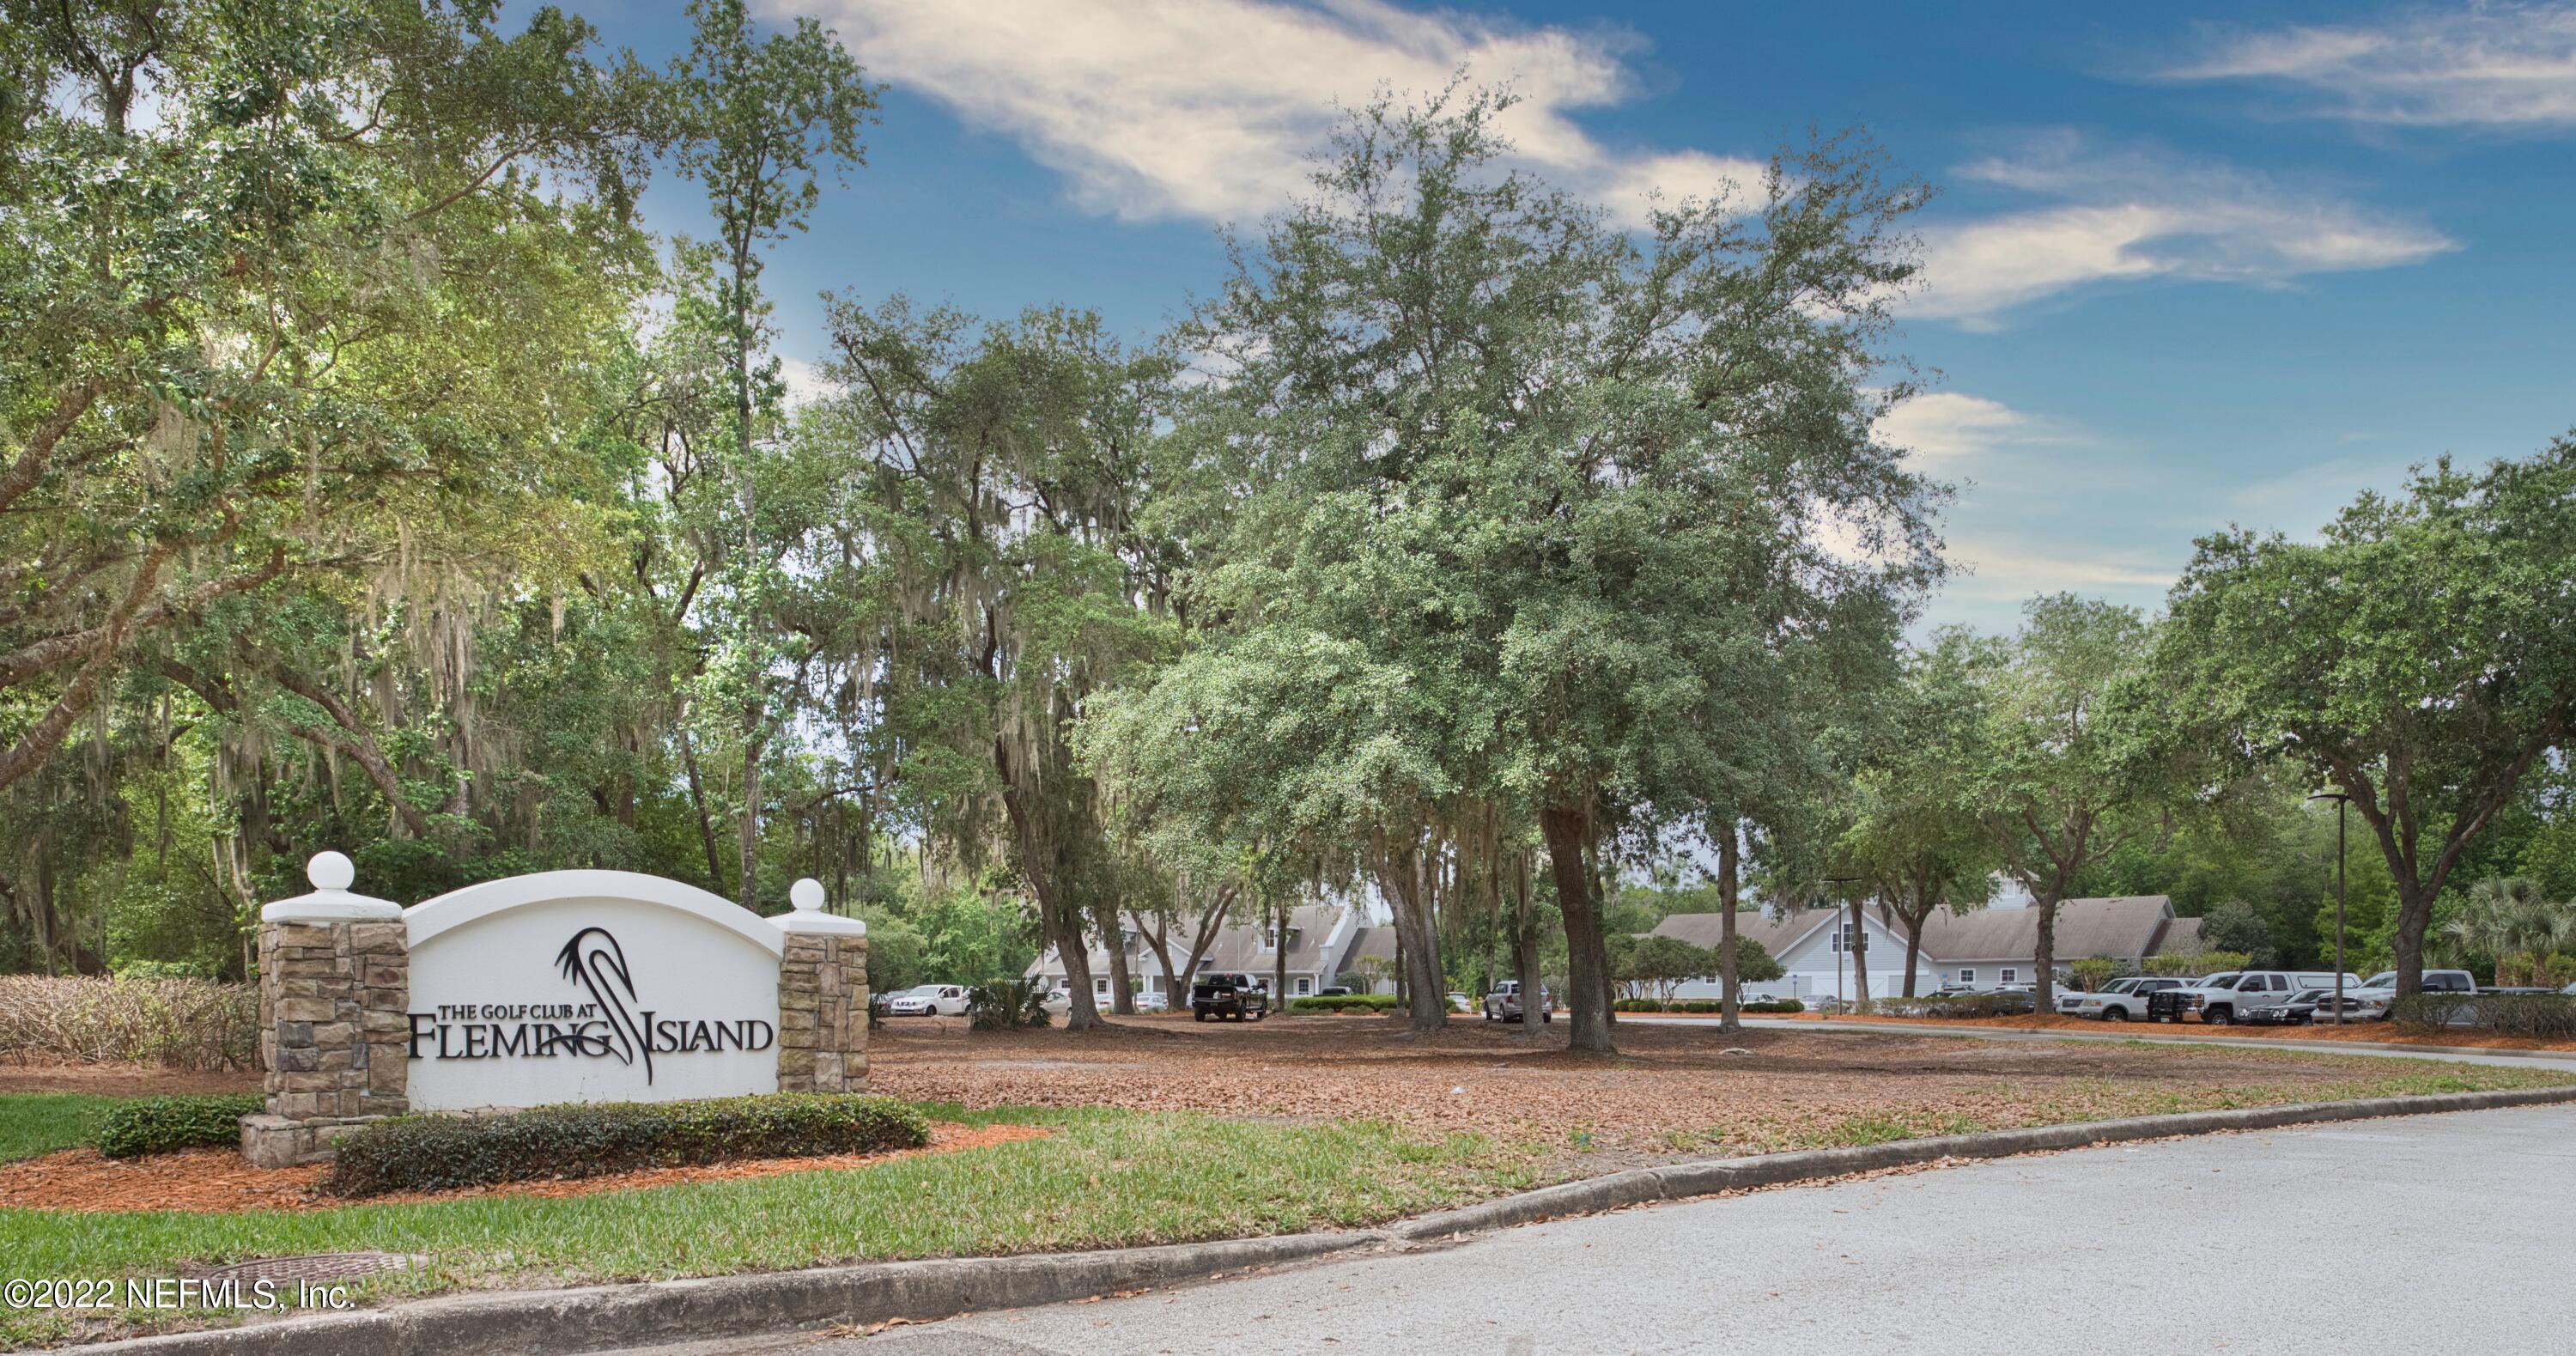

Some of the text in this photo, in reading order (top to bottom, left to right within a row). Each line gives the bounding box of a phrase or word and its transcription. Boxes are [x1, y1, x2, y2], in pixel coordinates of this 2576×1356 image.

[437, 1003, 598, 1020] THE GOLF CLUB AT
[407, 1011, 774, 1059] FLEMING ISLAND
